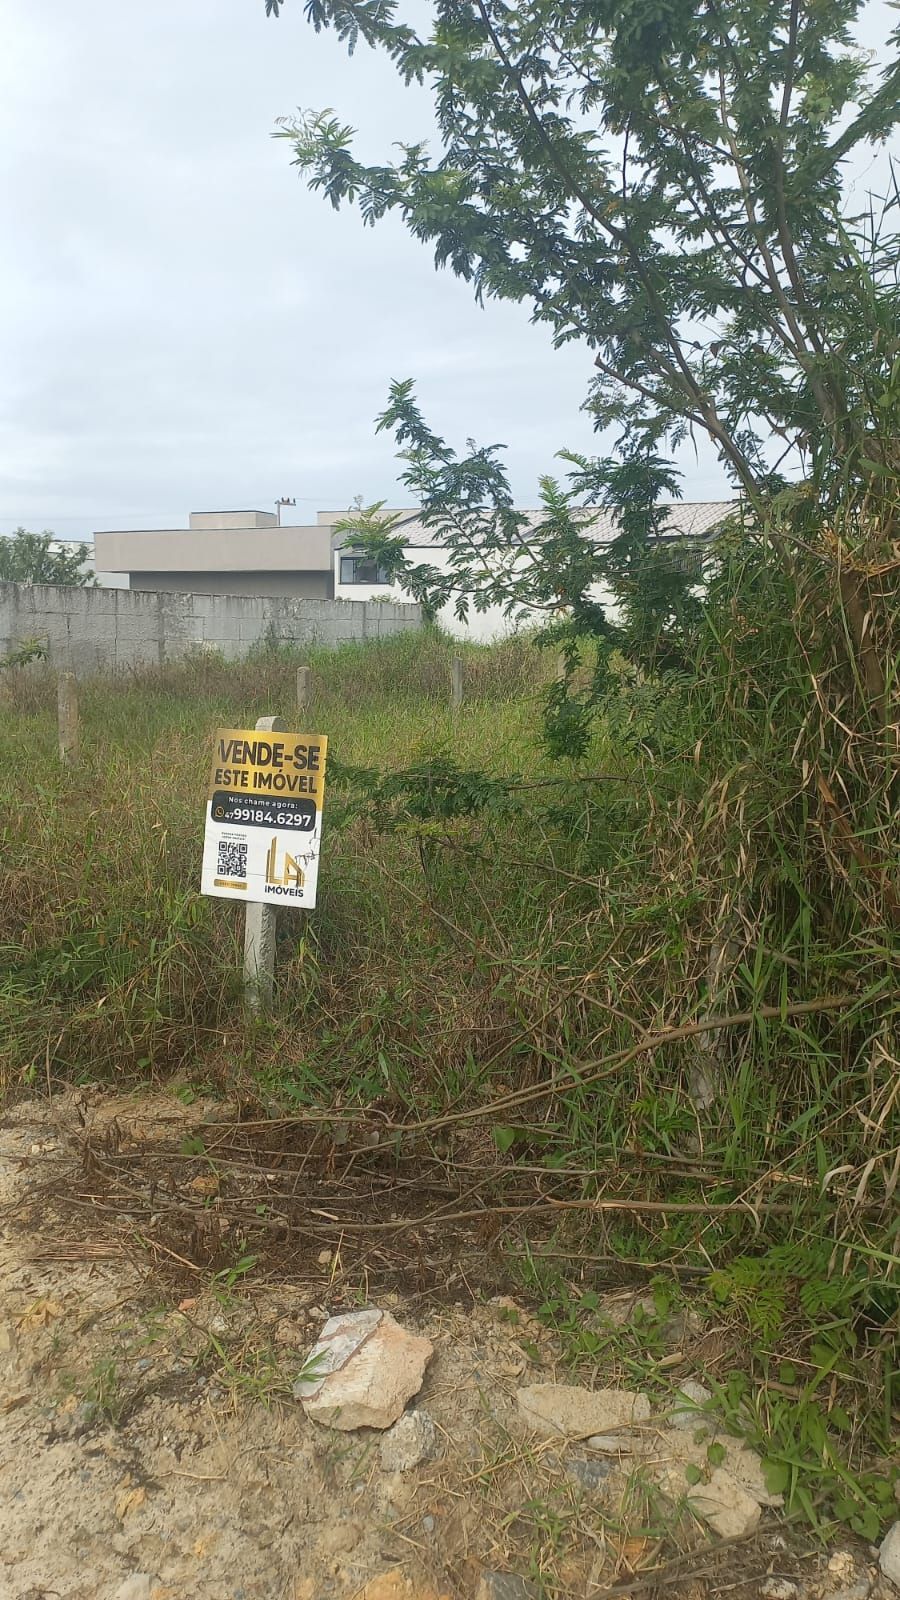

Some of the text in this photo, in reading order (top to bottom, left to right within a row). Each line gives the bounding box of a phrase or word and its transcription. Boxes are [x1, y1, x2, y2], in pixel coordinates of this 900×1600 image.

[218, 739, 320, 770] VENDE-SE
[215, 769, 318, 793] ESTE IMÓVEL
[244, 797, 270, 807] chame
[272, 800, 298, 809] agora:
[234, 808, 311, 827] 99184.6297
[264, 885, 304, 898] IMÓVEIS
